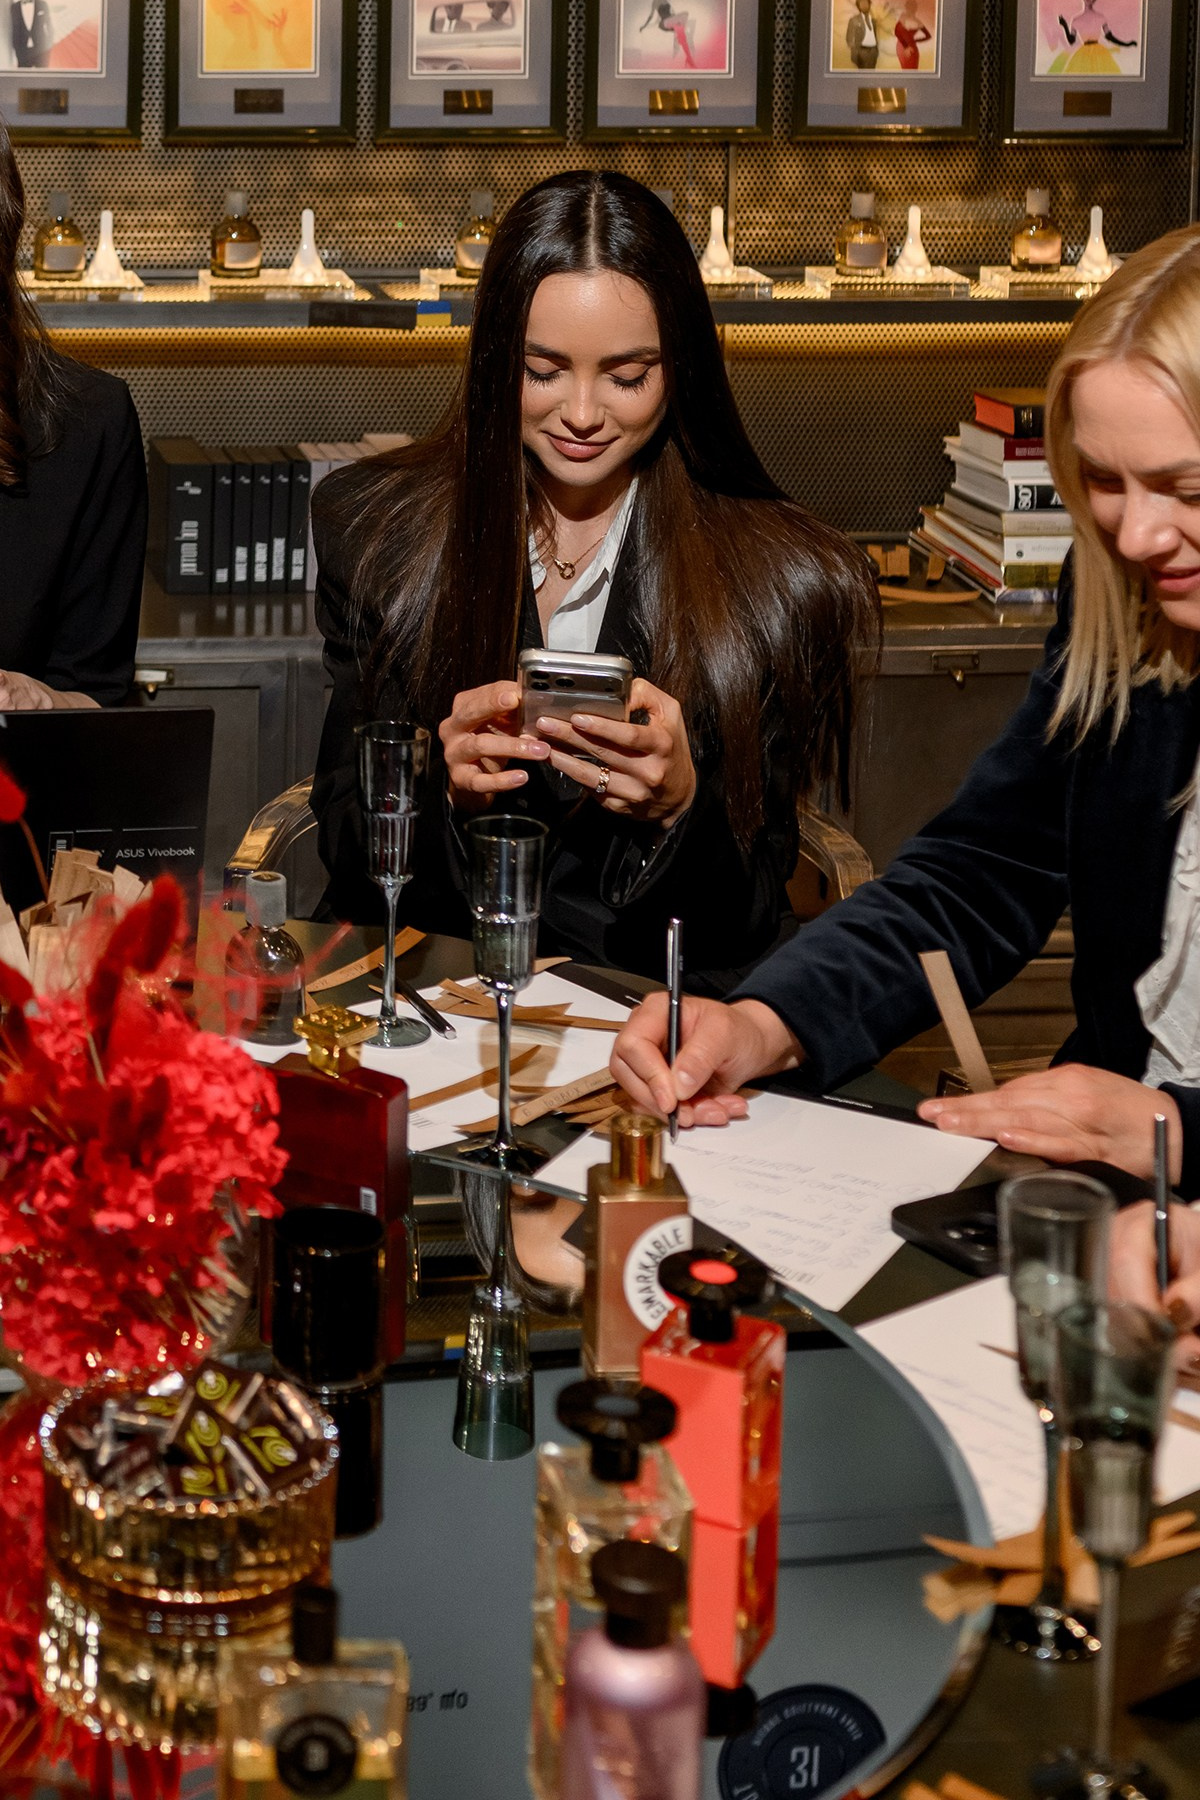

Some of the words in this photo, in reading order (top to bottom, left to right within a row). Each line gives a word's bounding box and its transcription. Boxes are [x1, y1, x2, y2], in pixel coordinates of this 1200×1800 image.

[115, 848, 145, 859] ASUS
[147, 846, 196, 858] Vivobook
[635, 1227, 685, 1320] EMARKABLE
